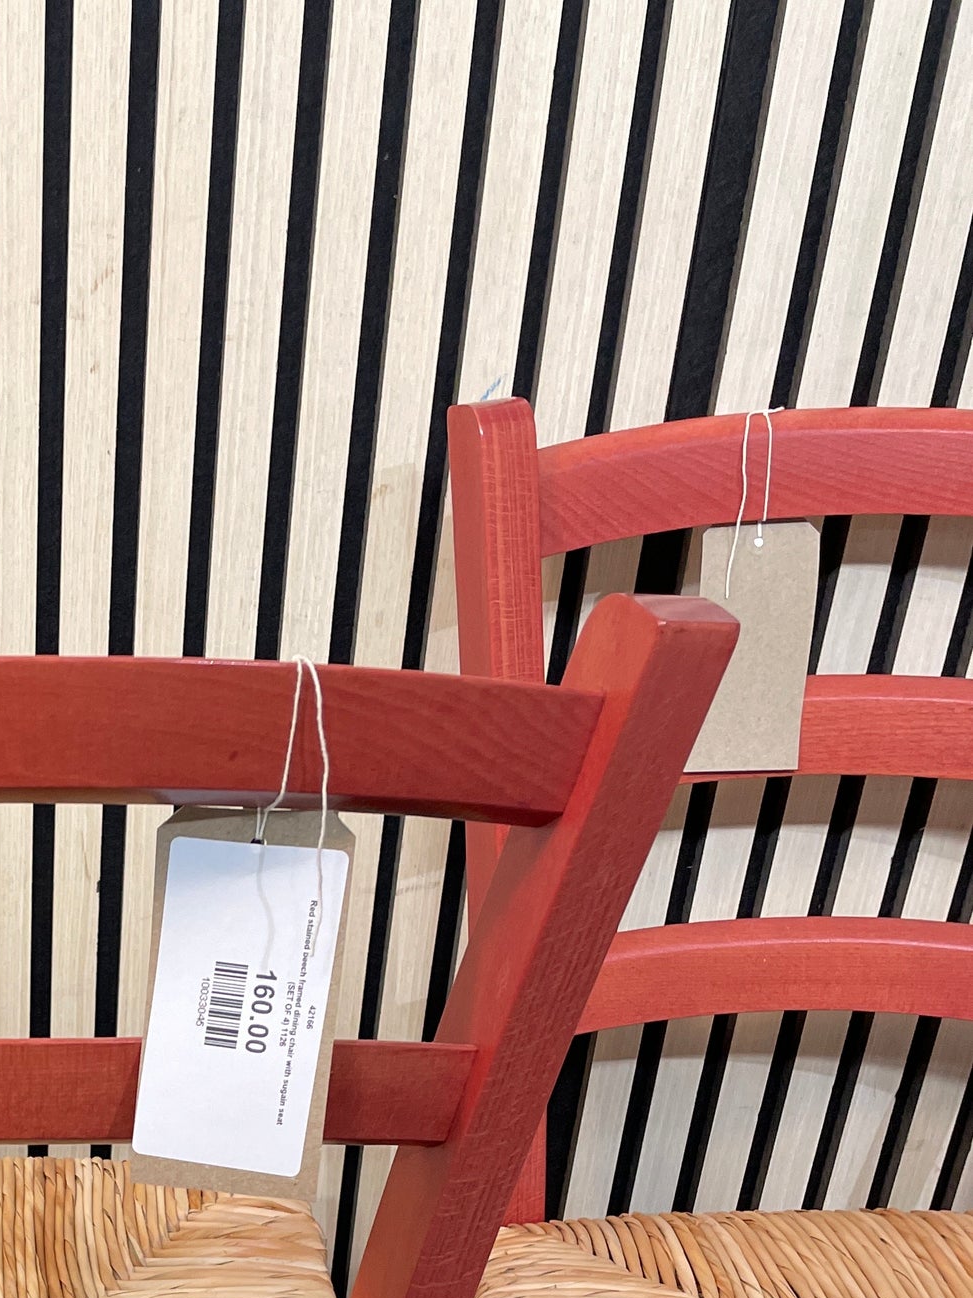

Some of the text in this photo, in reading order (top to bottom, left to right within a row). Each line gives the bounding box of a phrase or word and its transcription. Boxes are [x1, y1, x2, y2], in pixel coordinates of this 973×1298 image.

[308, 900, 318, 917] Red
[304, 919, 314, 950] stained
[196, 977, 211, 1027] 10033045
[295, 979, 307, 1008] framed
[245, 970, 278, 1054] 160.00
[279, 981, 296, 1047] (SET OF 4) 1126
[289, 1009, 301, 1036] dining
[306, 1005, 317, 1030] 42166
[287, 1037, 296, 1059] chair
[284, 1060, 292, 1077] with
[280, 1079, 289, 1106] sugain
[276, 1108, 284, 1125] seat
